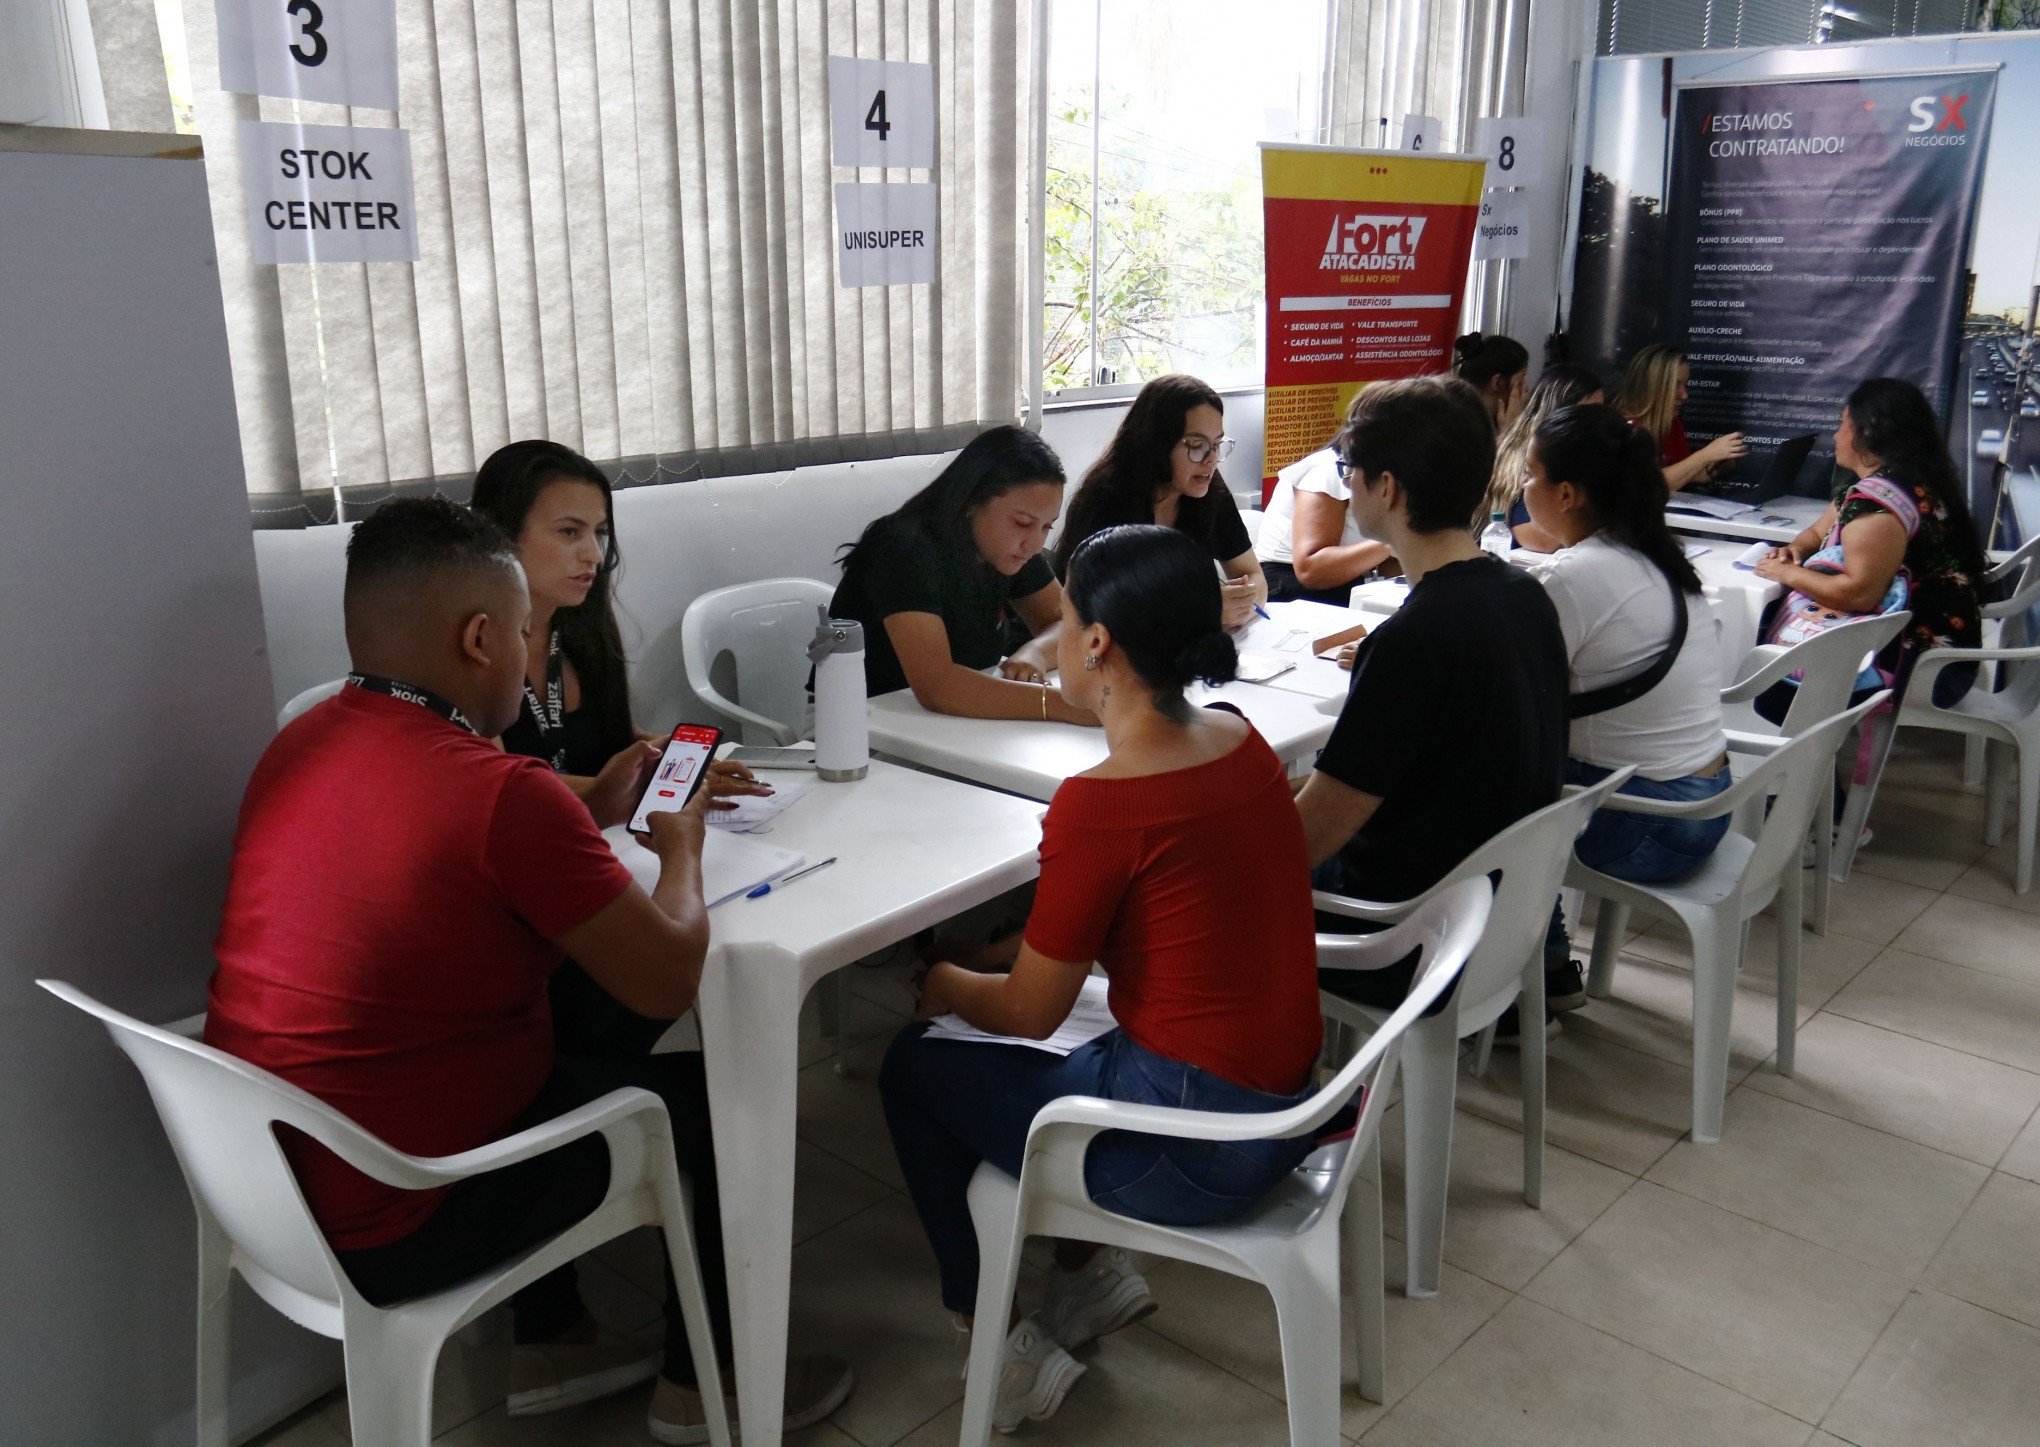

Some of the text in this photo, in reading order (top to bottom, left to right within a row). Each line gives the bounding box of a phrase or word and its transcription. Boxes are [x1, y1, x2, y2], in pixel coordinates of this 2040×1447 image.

[286, 0, 328, 67] 3
[865, 89, 891, 141] 4
[1908, 95, 1970, 133] SX
[1905, 134, 1967, 148] NEGÓCIOS
[1709, 136, 1845, 158] CONTRATANDO!
[1498, 136, 1515, 171] 8
[280, 149, 373, 180] STOK
[1481, 203, 1492, 216] Sx
[1699, 208, 1743, 217] BÔNUS (PPR)
[265, 201, 401, 231] CENTER
[1480, 223, 1519, 239] Negócios
[844, 230, 925, 250] UNISUPER
[1697, 236, 1719, 244] PLANO
[1730, 235, 1754, 244] SAÚDE
[1754, 236, 1784, 244] UNIMED
[1319, 254, 1416, 270] ATACADISTA
[1717, 263, 1773, 272] ODONTOLÓGICO
[1340, 274, 1401, 283] VAGAS NO FORT
[1347, 297, 1392, 307] BENEFÍCIOS
[1718, 300, 1728, 308] DE
[1290, 322, 1344, 331] SEGURO DE VIDA
[1357, 320, 1419, 329] VALE TRANSPORTE
[1688, 326, 1742, 335] AUXÍLIO-CRECHE
[1290, 335, 1343, 347] CAFÉ DA MANHÃ
[1356, 336, 1397, 344] DESCONTOS
[1411, 335, 1431, 343] LOJAS
[1355, 349, 1398, 359] ASSISTÊNCIA
[1687, 380, 1720, 388] EM-ESTAR
[1268, 390, 1297, 398] AUXILIAR
[1268, 399, 1296, 407] AUXILIAR
[1267, 407, 1296, 415] AUXILIAR
[1267, 423, 1303, 432] PROMOTOR
[1267, 431, 1302, 440] PROMOTOR
[1267, 439, 1301, 448] REPOSITOR
[1301, 438, 1310, 446] DE
[1267, 447, 1304, 456] SEPARADOR
[1267, 456, 1293, 465] TÉCNICO
[547, 681, 564, 728] zaffari
